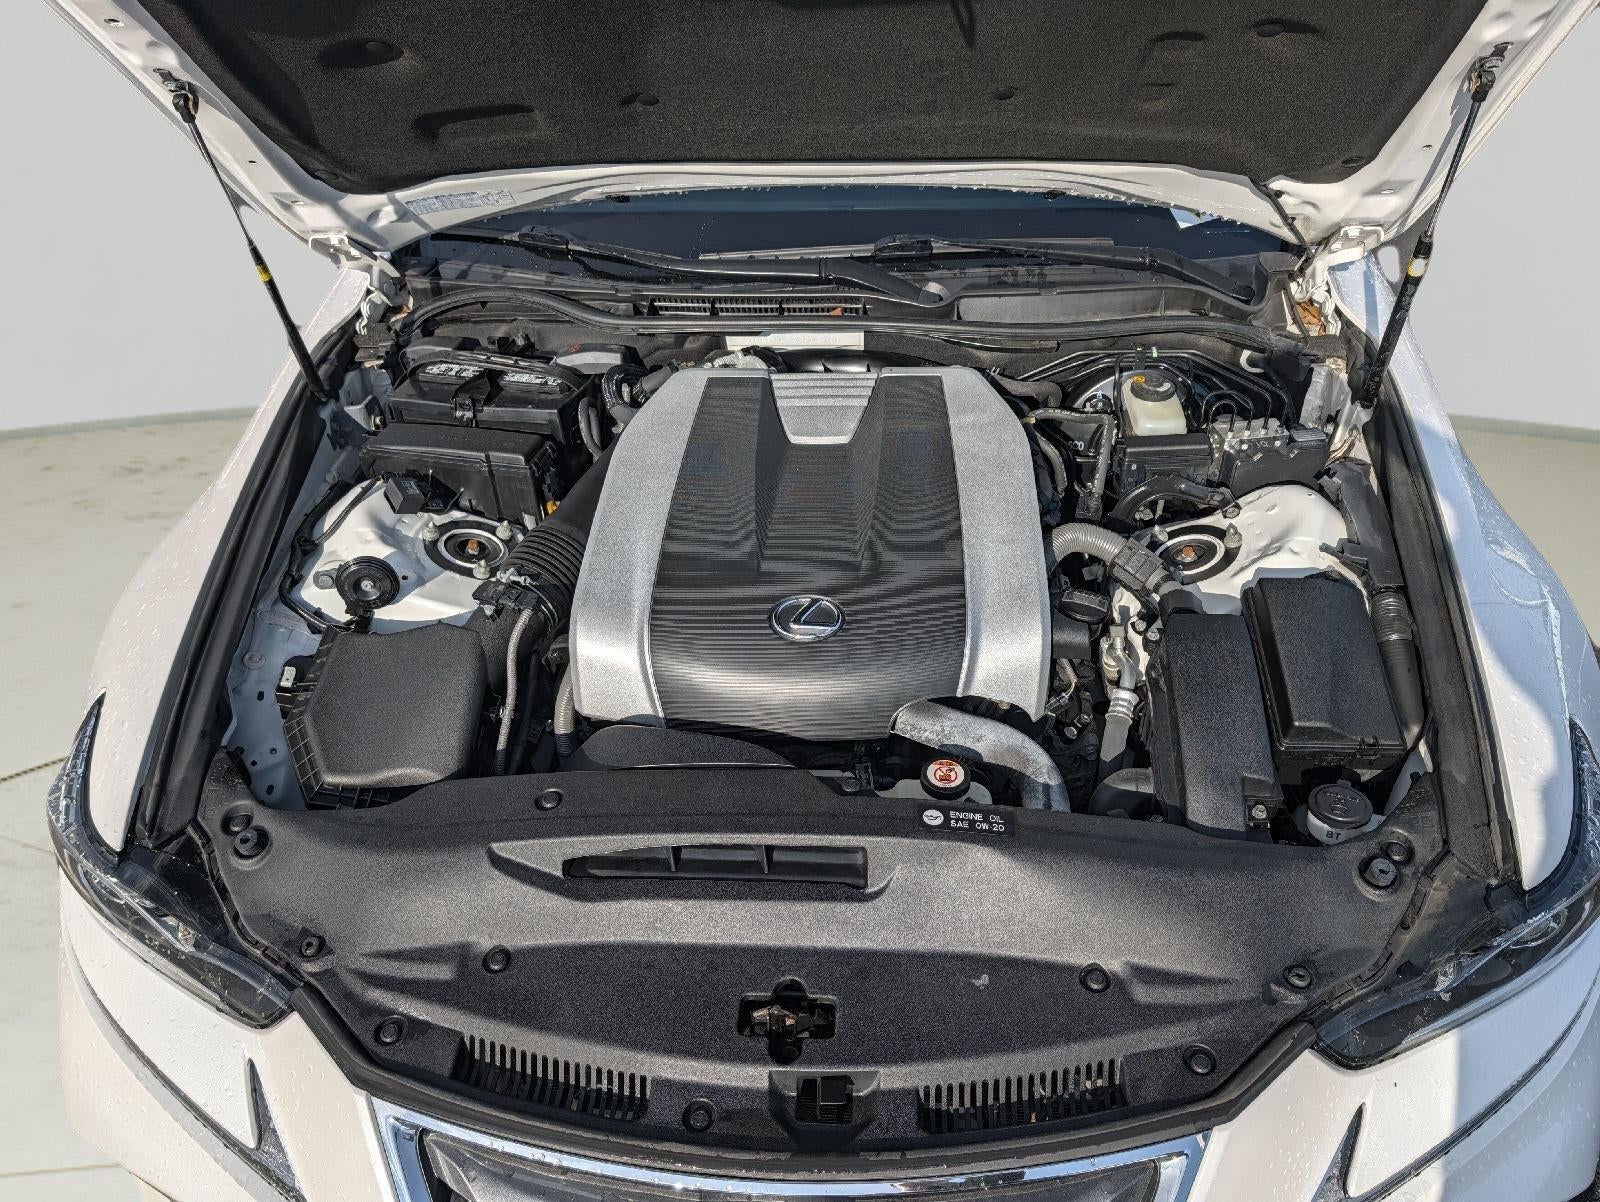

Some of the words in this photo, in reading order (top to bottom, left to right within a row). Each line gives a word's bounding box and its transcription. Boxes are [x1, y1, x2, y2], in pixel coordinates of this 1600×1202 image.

[949, 811, 983, 821] ENGINE
[989, 814, 1005, 823] OIL
[950, 820, 970, 829] SAE
[975, 822, 1005, 832] 0W-20
[1325, 831, 1342, 841] BT
